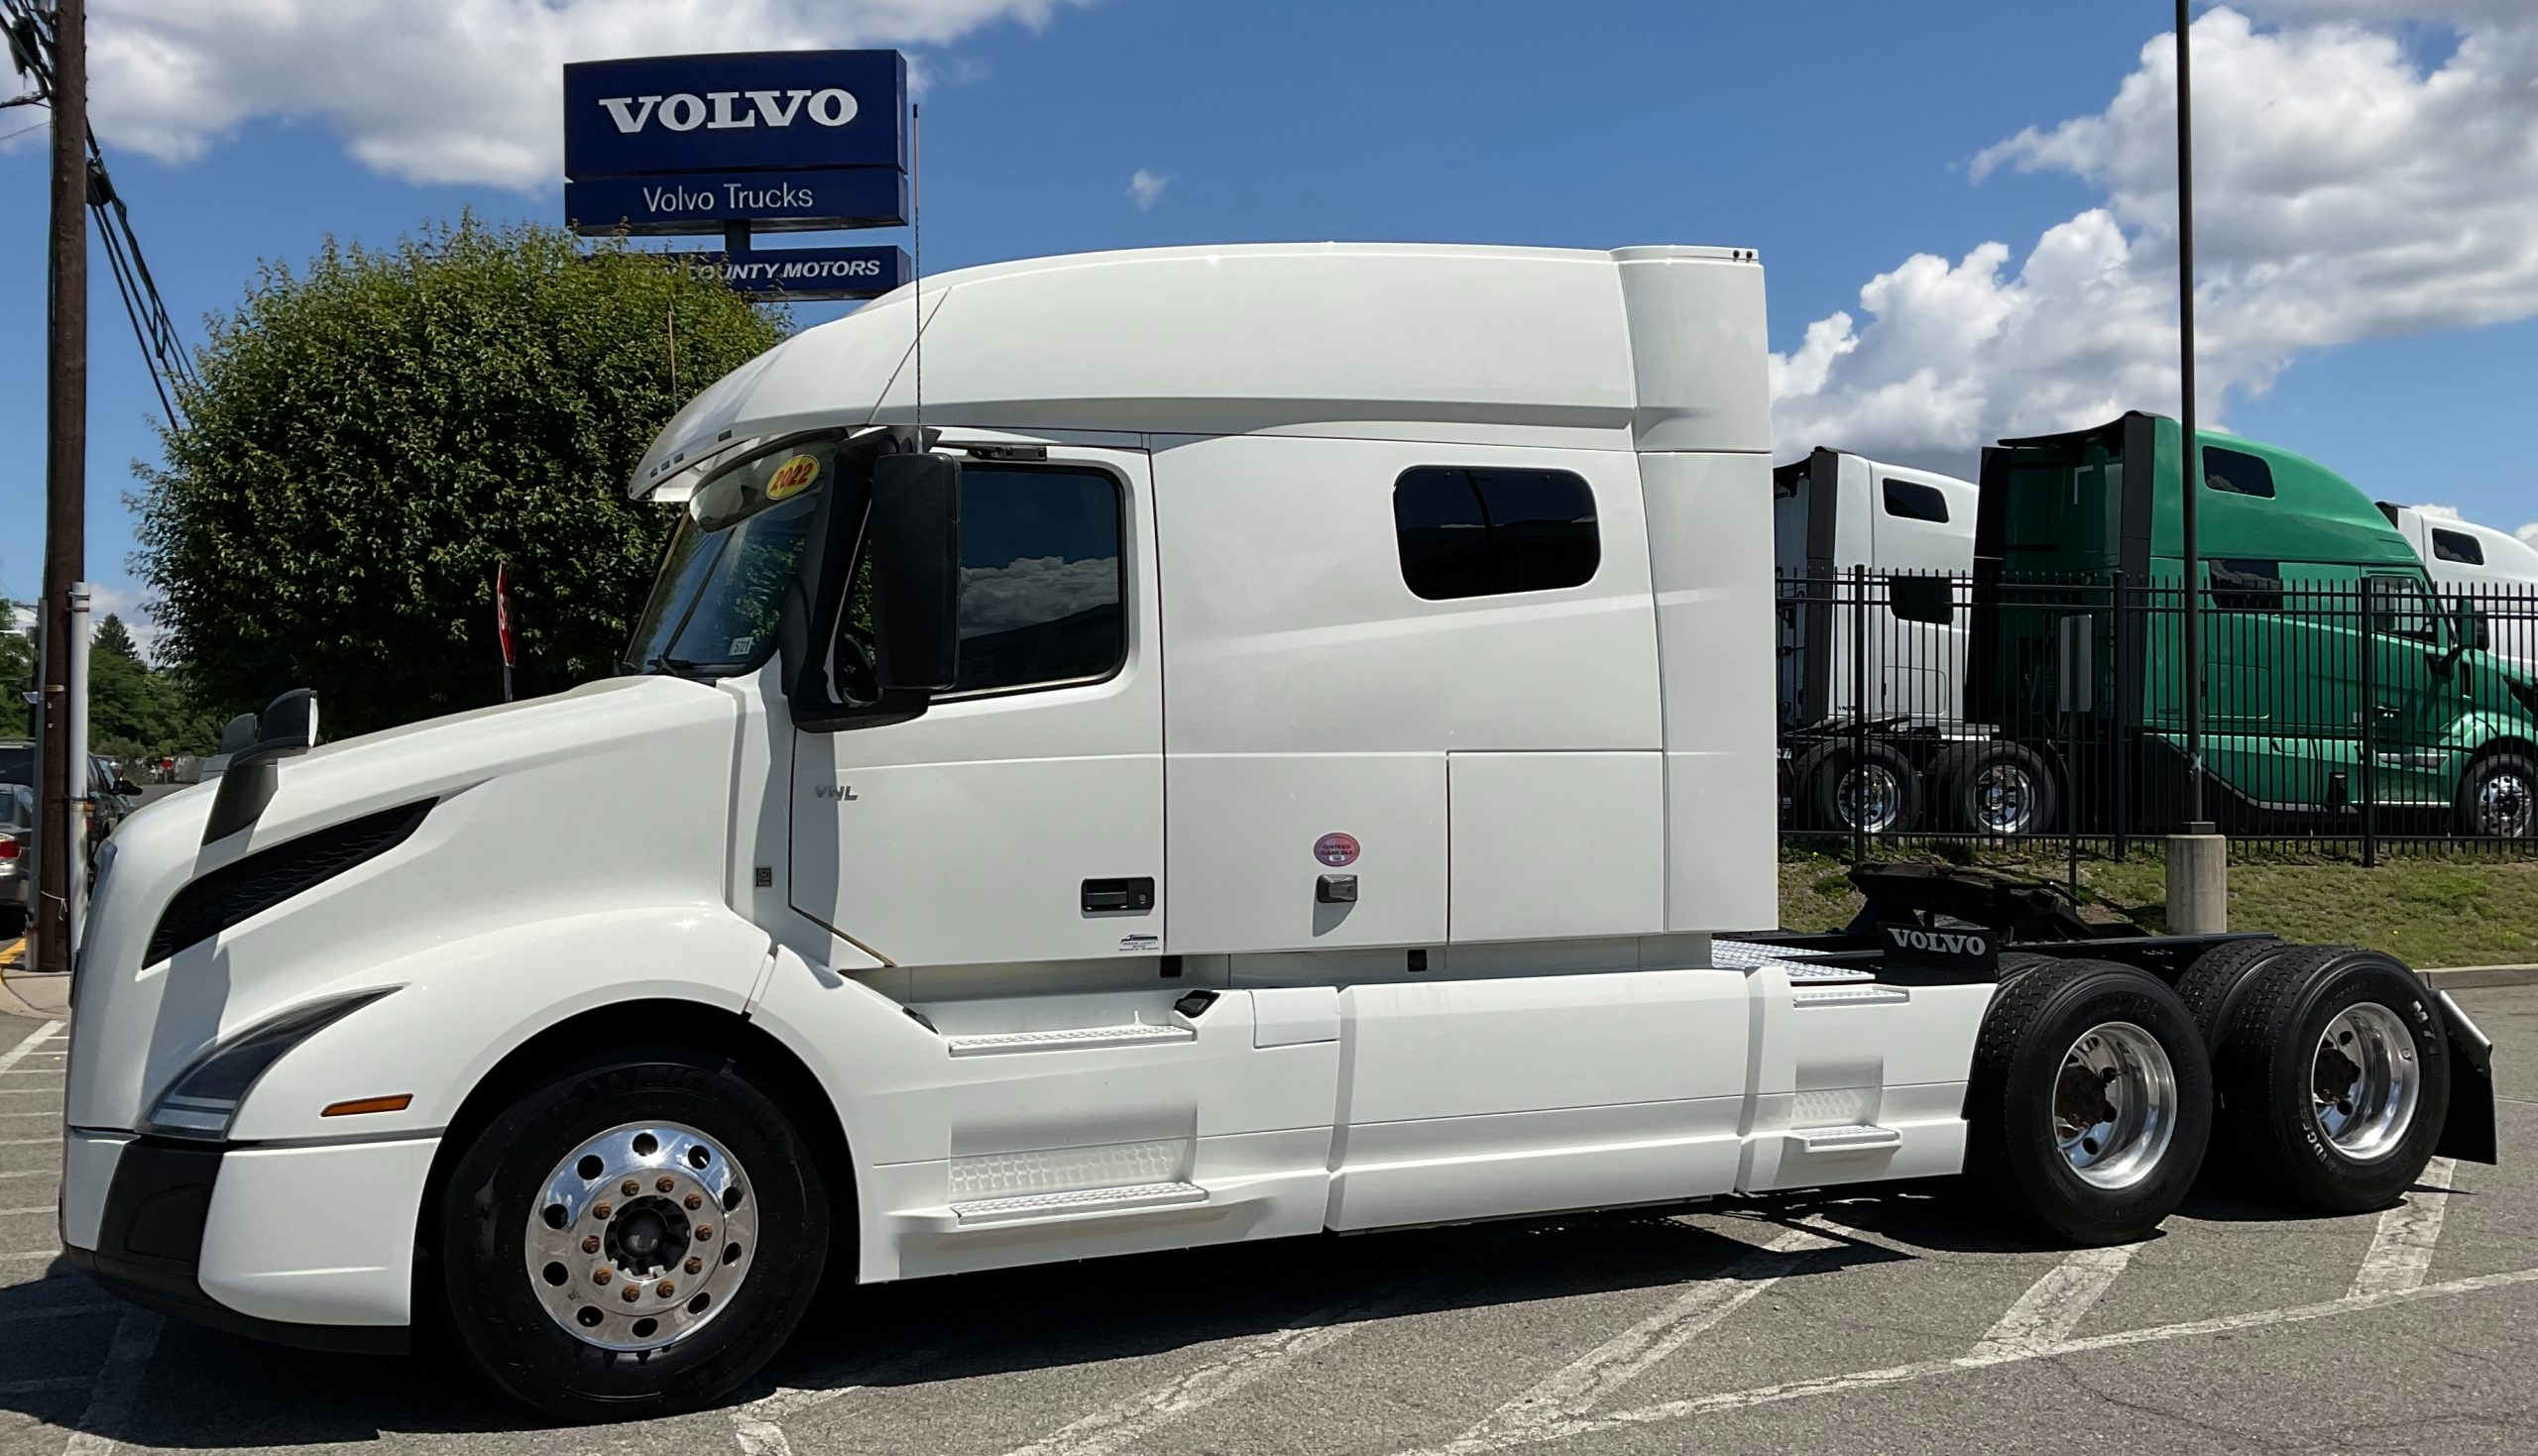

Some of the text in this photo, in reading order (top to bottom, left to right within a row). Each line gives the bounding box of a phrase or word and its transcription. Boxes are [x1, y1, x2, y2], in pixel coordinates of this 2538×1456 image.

[598, 88, 858, 133] VOLVO
[643, 181, 813, 212] Volvo Trucks
[782, 260, 880, 279] MOTORS
[770, 462, 813, 492] 2022
[815, 785, 859, 801] VNL
[1887, 928, 1986, 955] VOLVO
